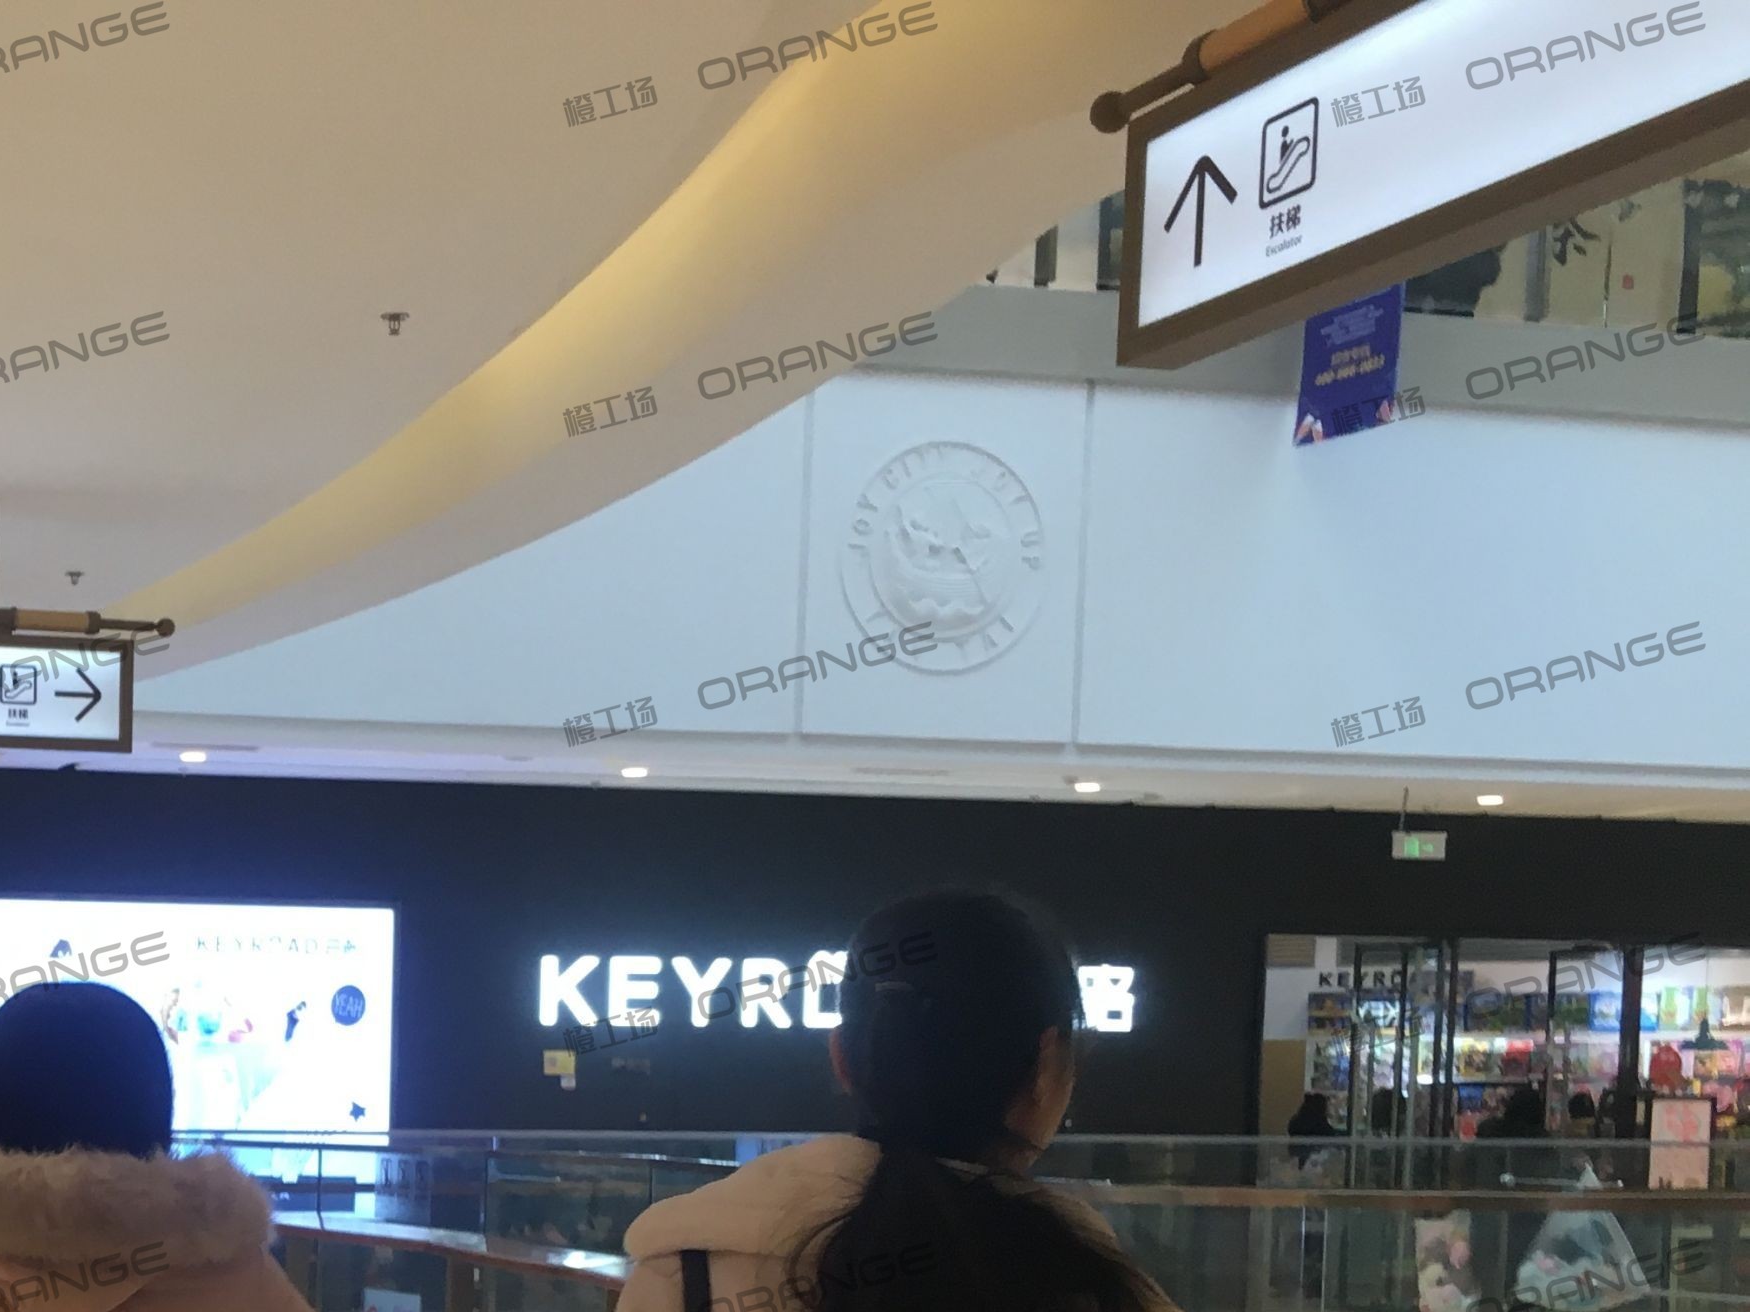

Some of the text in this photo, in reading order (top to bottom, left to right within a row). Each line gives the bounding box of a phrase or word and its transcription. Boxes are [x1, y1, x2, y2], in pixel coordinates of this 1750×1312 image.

[1269, 204, 1301, 239] 扶梯
[334, 993, 365, 1019] YEAH
[537, 948, 845, 1031] KEYRO
